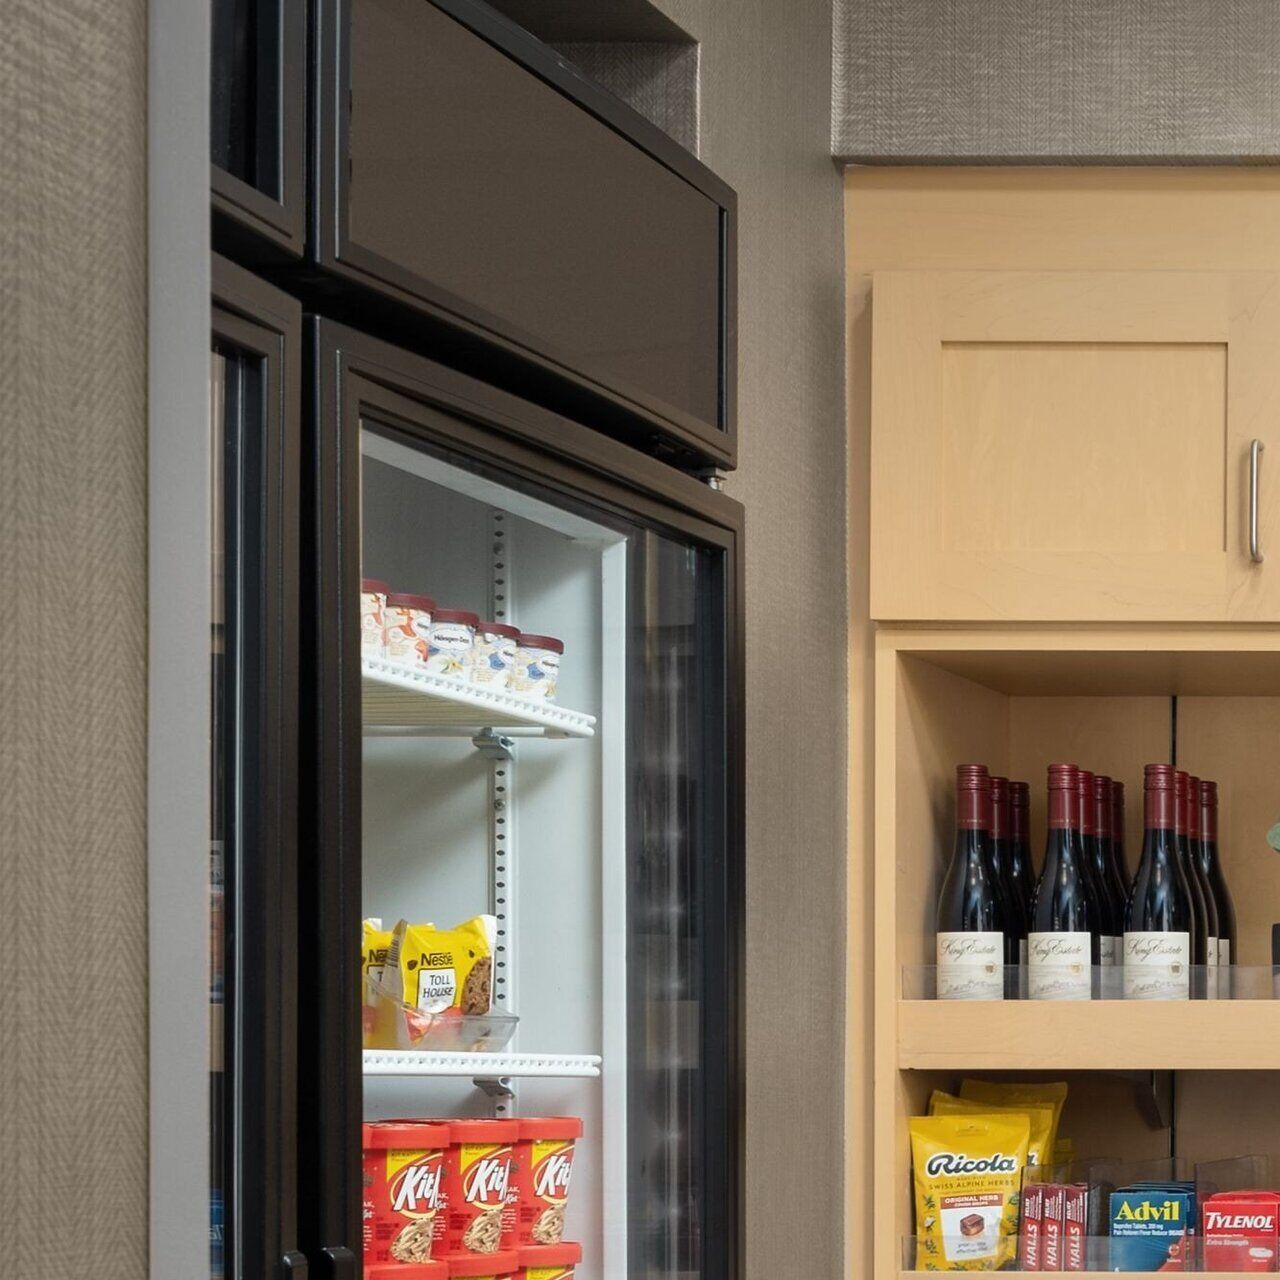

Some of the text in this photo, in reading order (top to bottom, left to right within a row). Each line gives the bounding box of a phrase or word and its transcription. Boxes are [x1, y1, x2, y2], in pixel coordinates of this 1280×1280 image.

[430, 974, 451, 986] TOLL
[423, 986, 454, 999] HOUSE
[927, 1154, 1016, 1176] Ricola
[944, 1194, 999, 1204] ORIGINAL HERB
[1114, 1201, 1180, 1221] Advil
[1206, 1212, 1273, 1229] TYLENOL
[1027, 1223, 1038, 1266] HALLS
[1047, 1223, 1058, 1267] HALLS
[1070, 1227, 1080, 1268] HALLS
